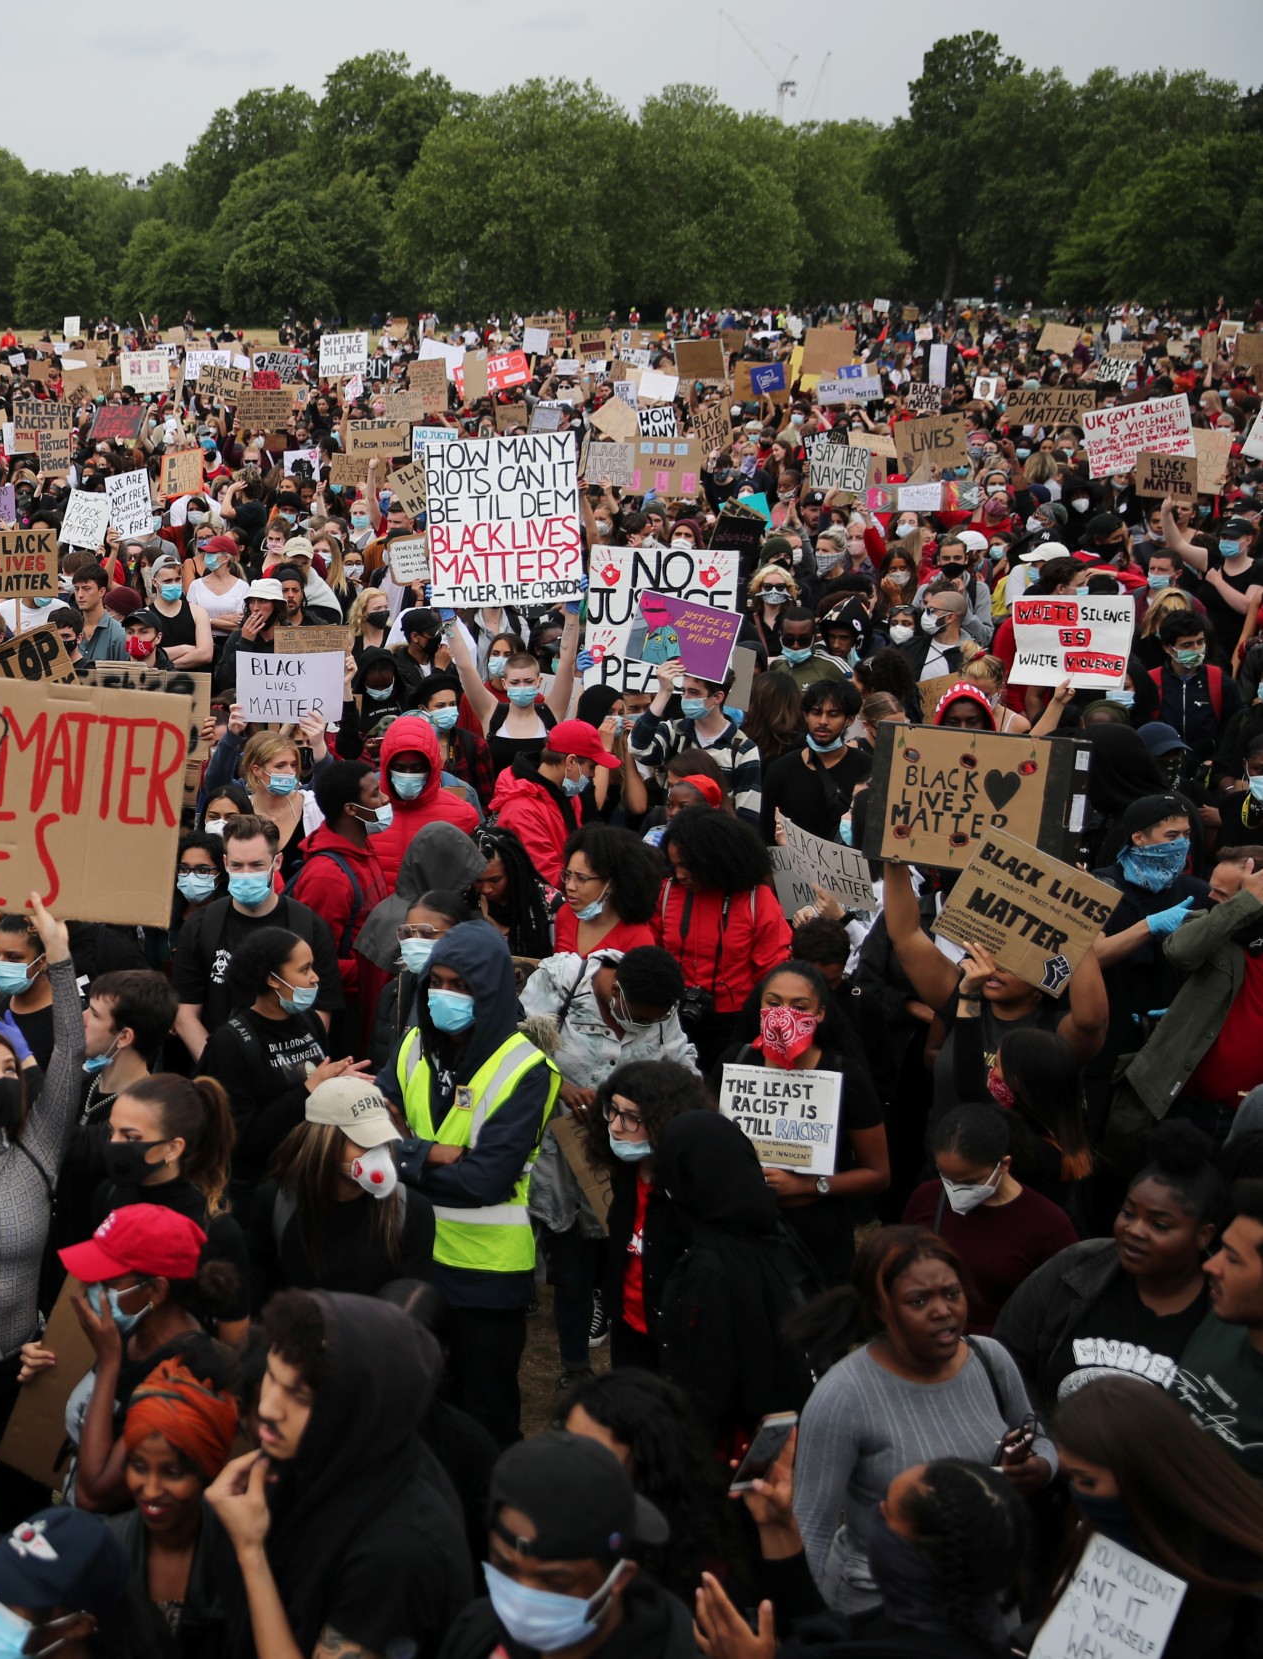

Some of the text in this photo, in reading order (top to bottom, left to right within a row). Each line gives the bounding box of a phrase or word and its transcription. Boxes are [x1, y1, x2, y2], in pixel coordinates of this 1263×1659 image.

[323, 338, 362, 346] WHITE
[323, 344, 364, 355] SILENCE
[267, 351, 299, 366] BLACK
[320, 360, 365, 375] VIOLENCE
[1100, 358, 1132, 370] BLACK
[201, 364, 241, 383] SILENCE
[365, 358, 391, 380] BLM
[198, 382, 238, 399] VIOLENCE
[819, 383, 879, 399] BLACK LIVES MATTER
[911, 382, 941, 395] BLACK
[908, 400, 940, 411] MATTER
[915, 394, 937, 402] LIVES
[1006, 390, 1094, 409] BLACK LIVES
[17, 402, 72, 417] THE LEAST
[639, 409, 674, 427] HOW
[693, 407, 723, 429] BLACK
[1021, 407, 1079, 424] MATTER
[1085, 397, 1183, 431] UK GOVT SILENCE
[14, 415, 55, 430] RACIST
[58, 416, 70, 430] IS
[641, 423, 679, 438] MANY
[15, 432, 35, 440] STILL
[39, 432, 52, 441] NO
[353, 438, 403, 449] RACISM TAUGHT
[415, 430, 458, 441] NO JUSTICE
[910, 427, 955, 453] LIVES
[39, 439, 69, 451] JUSTICE
[425, 432, 572, 470] HOW MANY
[40, 452, 52, 460] NO
[40, 457, 69, 470] PEACE
[167, 450, 201, 470] BLACK
[649, 457, 676, 468] WHEN
[815, 442, 869, 468] SAY THEIR
[1148, 458, 1187, 474] BLACK
[425, 460, 576, 496] RIOTS CAN IT
[809, 466, 864, 492] NAMES
[1150, 469, 1184, 482] LIVES
[1142, 479, 1192, 496] MATTER
[112, 489, 148, 508] NOT FREE
[427, 489, 577, 524] BE TIL DEM
[72, 502, 102, 520] BLACK
[65, 513, 99, 530] LIVES
[430, 514, 582, 554] BLACK LIVES
[432, 547, 581, 586] MATTER?
[631, 550, 695, 590] NO
[446, 578, 583, 604] TYLER, THE CREATOR
[680, 610, 733, 629] JUSTICE IS
[1018, 603, 1131, 623] WHITE SILENCE
[281, 630, 349, 641] WE WILL FIGHT
[674, 619, 735, 642] MEANT TO BE
[1061, 631, 1086, 645] IS
[278, 641, 303, 650] UNTIL
[250, 656, 306, 677] BLACK
[1018, 652, 1123, 672] WHITE VIOLENCE
[265, 680, 297, 692] LIVES
[249, 697, 324, 718] MATTER
[905, 764, 979, 794] BLACK
[901, 788, 976, 813] LIVES
[817, 870, 876, 901] MATTER
[968, 862, 985, 877] (AND
[996, 878, 1025, 898] CANNOT
[1027, 894, 1048, 911] STRESS
[1049, 904, 1062, 916] THIS
[978, 840, 1113, 925] BLACK LIVES
[965, 886, 1070, 955] MATTER
[725, 1078, 814, 1100] THE LEAST
[730, 1094, 818, 1120] RACIST IS
[732, 1115, 834, 1144] STILL RACIST
[775, 1151, 811, 1161] INNOCENT
[1092, 1605, 1156, 1656] YOURSELF
